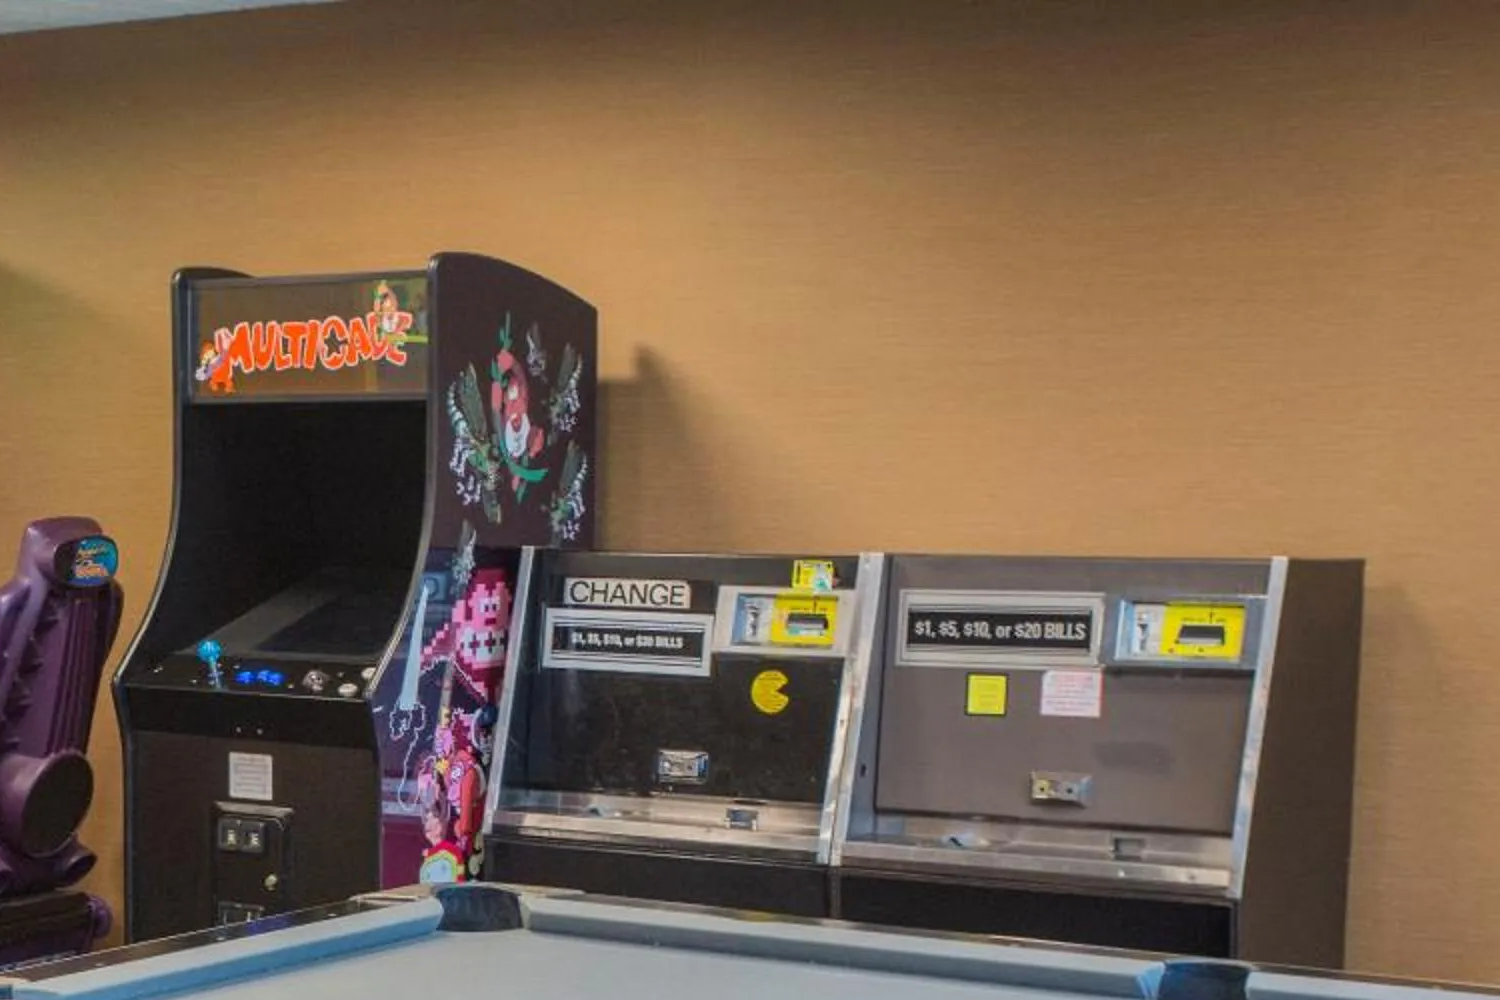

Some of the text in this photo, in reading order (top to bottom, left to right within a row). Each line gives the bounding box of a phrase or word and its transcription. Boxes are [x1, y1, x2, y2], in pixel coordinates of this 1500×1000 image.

[569, 580, 686, 606] CHANGE
[995, 624, 1013, 639] or
[1015, 622, 1042, 639] $20
[1044, 622, 1087, 640] BILLS
